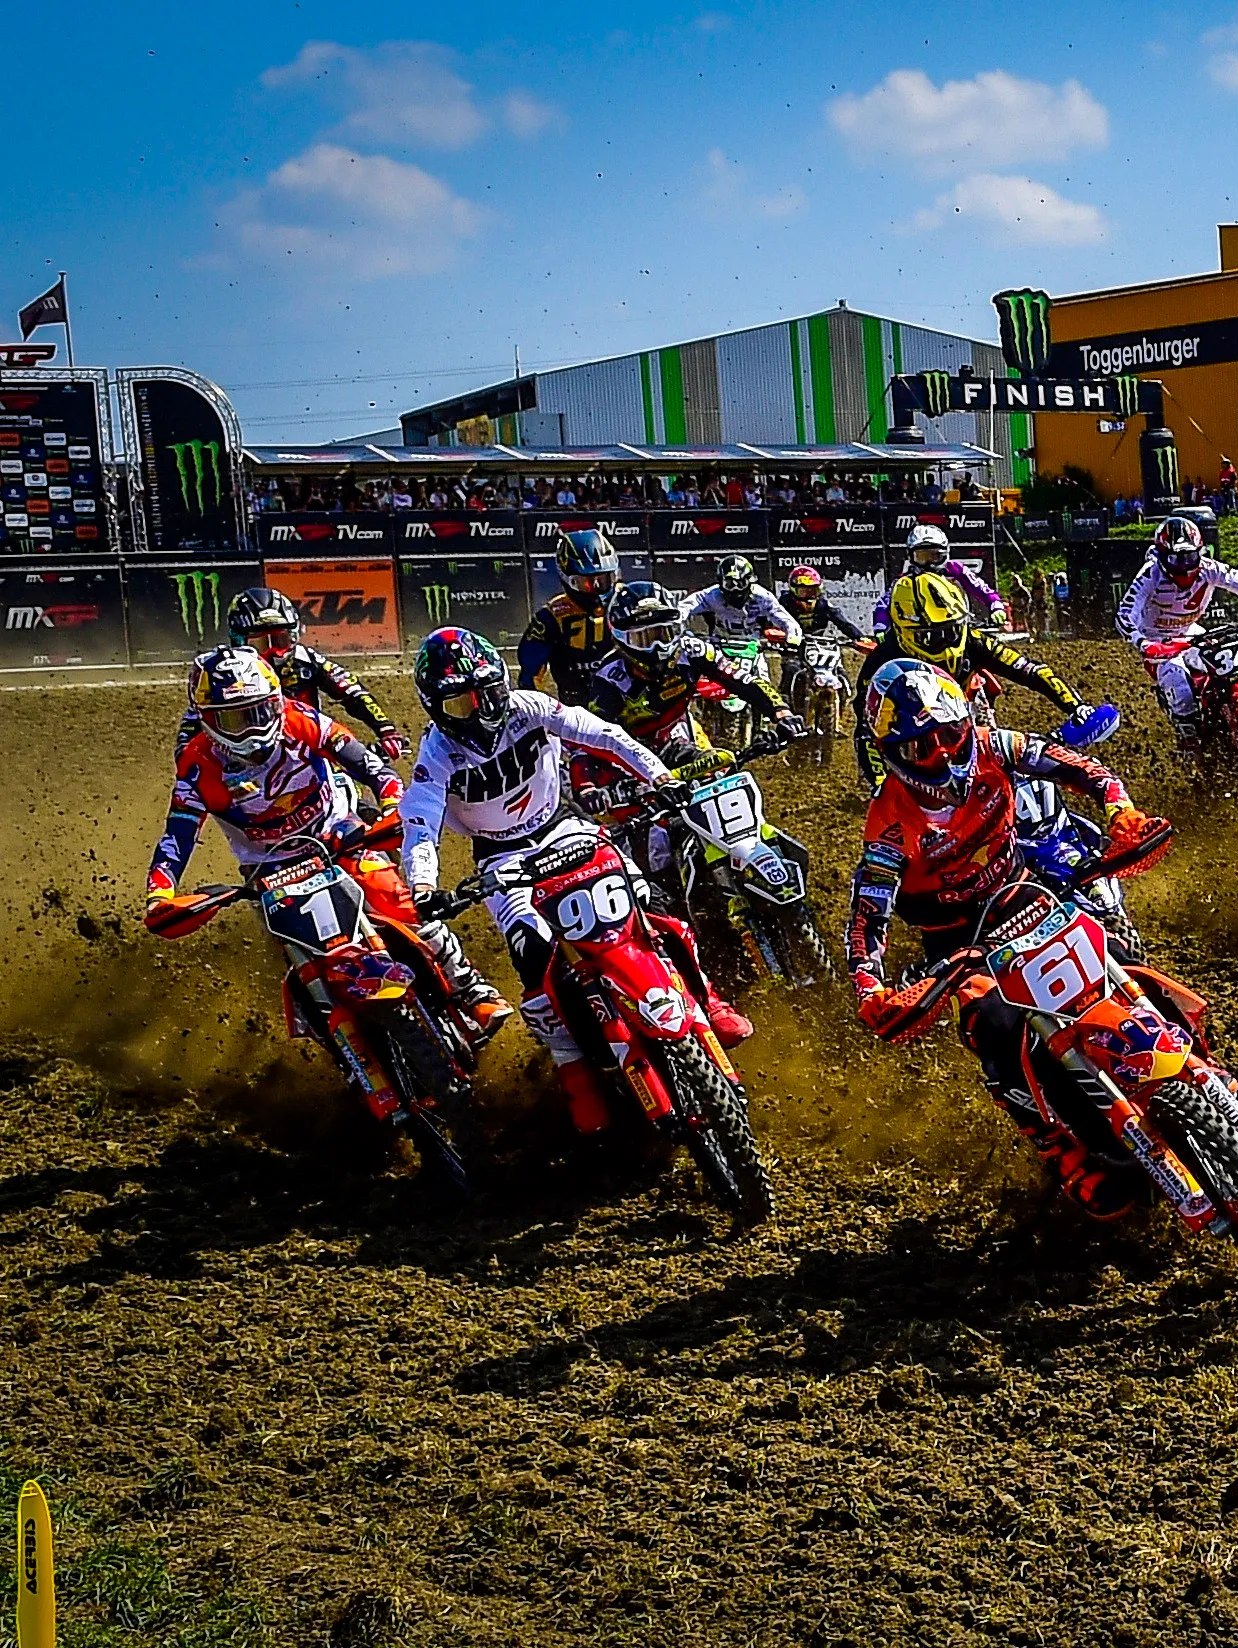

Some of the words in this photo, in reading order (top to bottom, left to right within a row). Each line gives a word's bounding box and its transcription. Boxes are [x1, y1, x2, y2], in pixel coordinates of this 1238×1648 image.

[1079, 336, 1201, 375] Toggenburger
[963, 382, 1106, 408] FINISH
[778, 556, 823, 567] FOLLOW
[824, 555, 841, 566] US
[700, 787, 756, 839] 19
[299, 888, 342, 942] 1
[557, 874, 631, 941] 96
[1000, 906, 1049, 940] ENTHAL
[1021, 923, 1106, 1013] 61
[24, 1517, 38, 1596] ACERBIS
